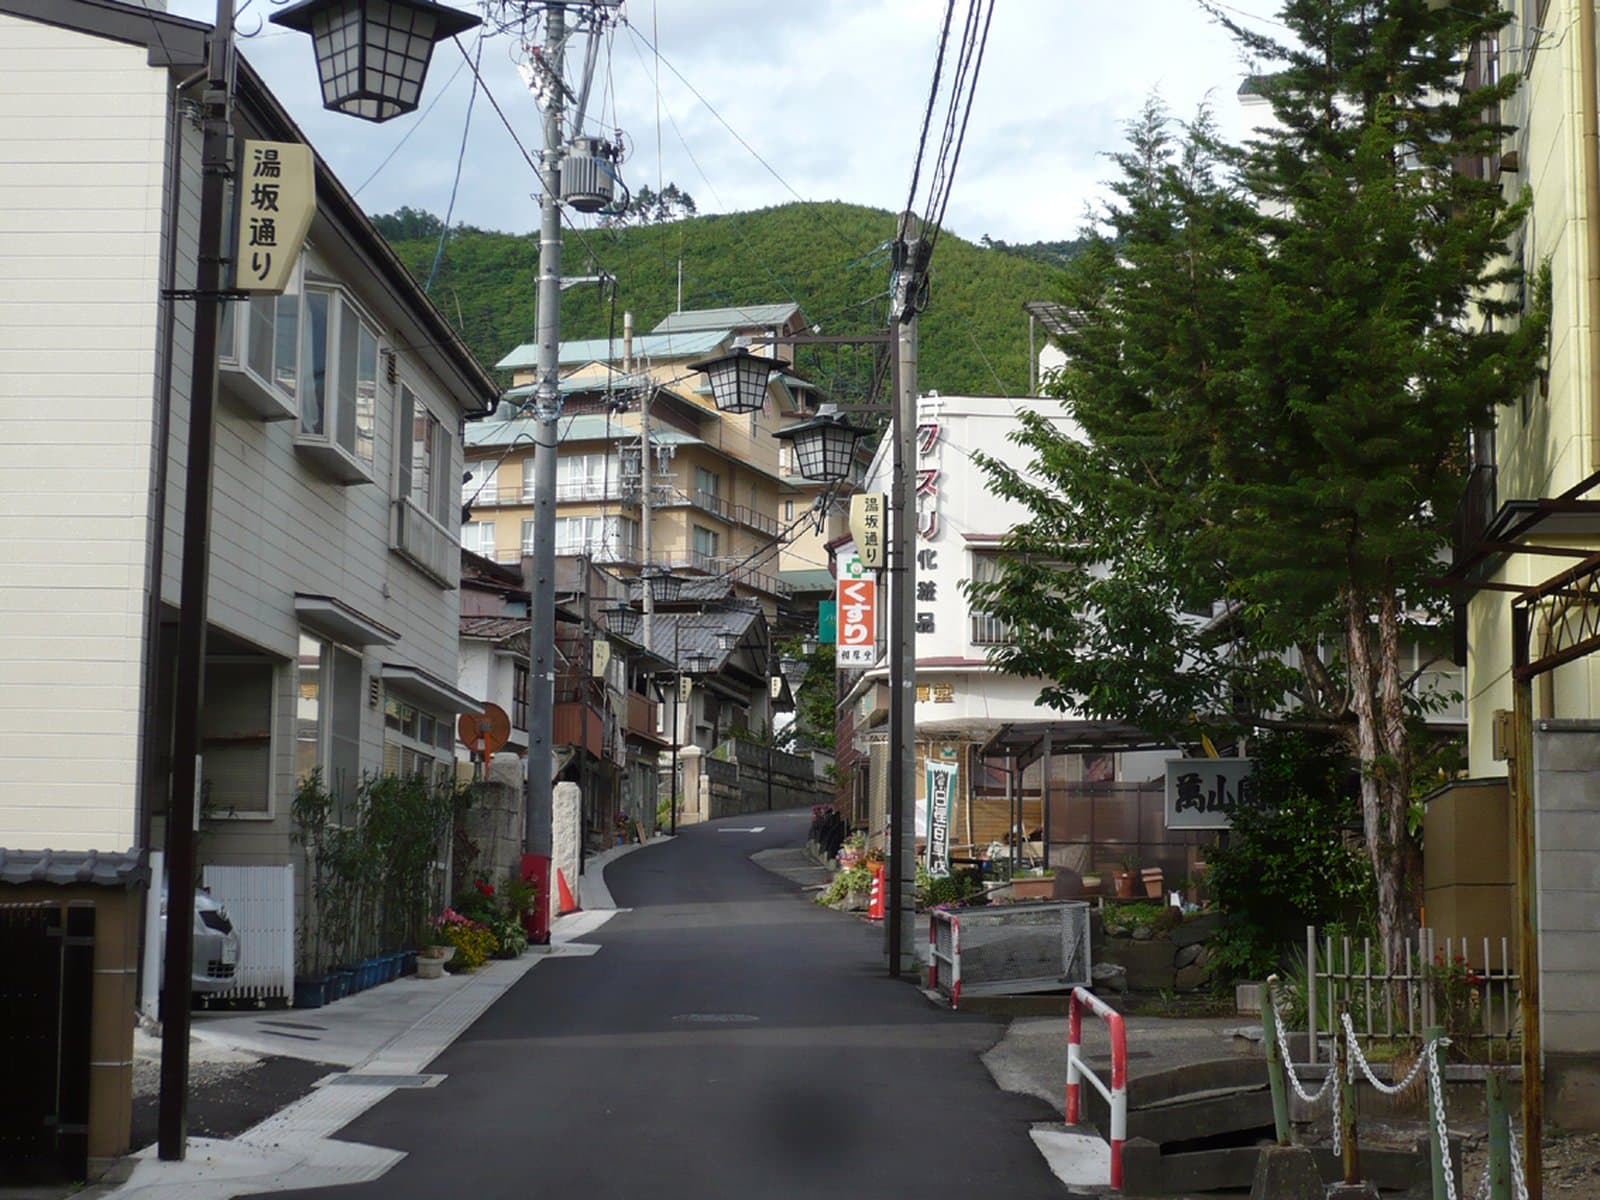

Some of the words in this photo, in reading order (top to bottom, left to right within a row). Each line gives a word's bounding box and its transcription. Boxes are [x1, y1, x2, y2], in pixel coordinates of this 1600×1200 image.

[248, 148, 281, 281] 湯坂通り
[864, 497, 879, 563] 湯坂通り
[842, 582, 871, 644] くすり
